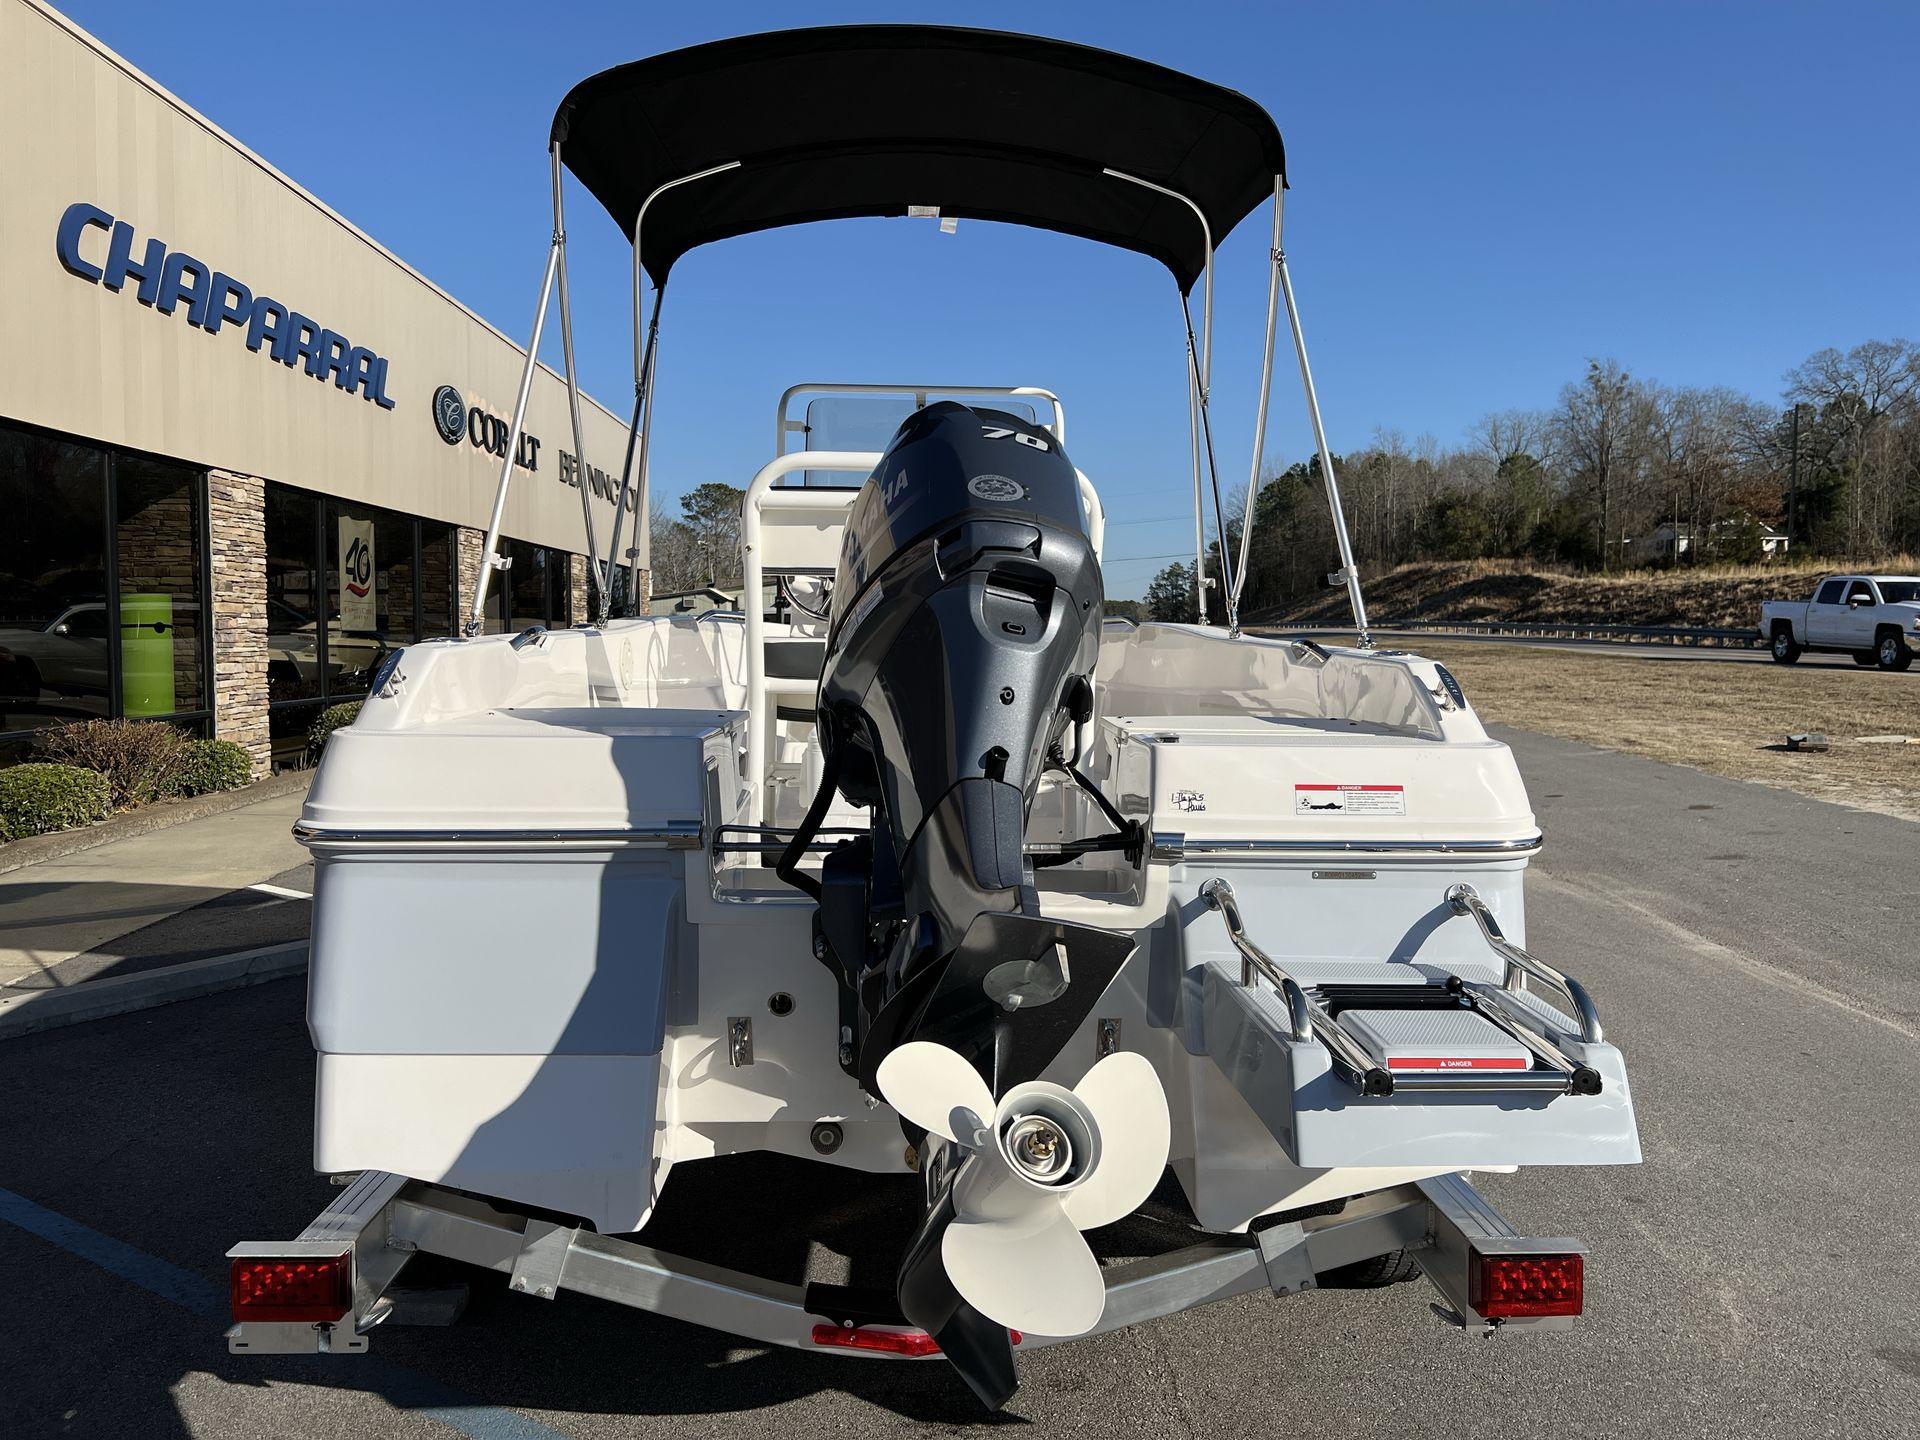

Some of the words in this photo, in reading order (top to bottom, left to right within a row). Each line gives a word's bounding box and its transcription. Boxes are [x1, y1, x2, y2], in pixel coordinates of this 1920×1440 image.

[56, 202, 396, 412] CHAPARRAL
[981, 425, 1049, 451] 70
[559, 449, 638, 514] BENINGO
[345, 537, 371, 586] 40
